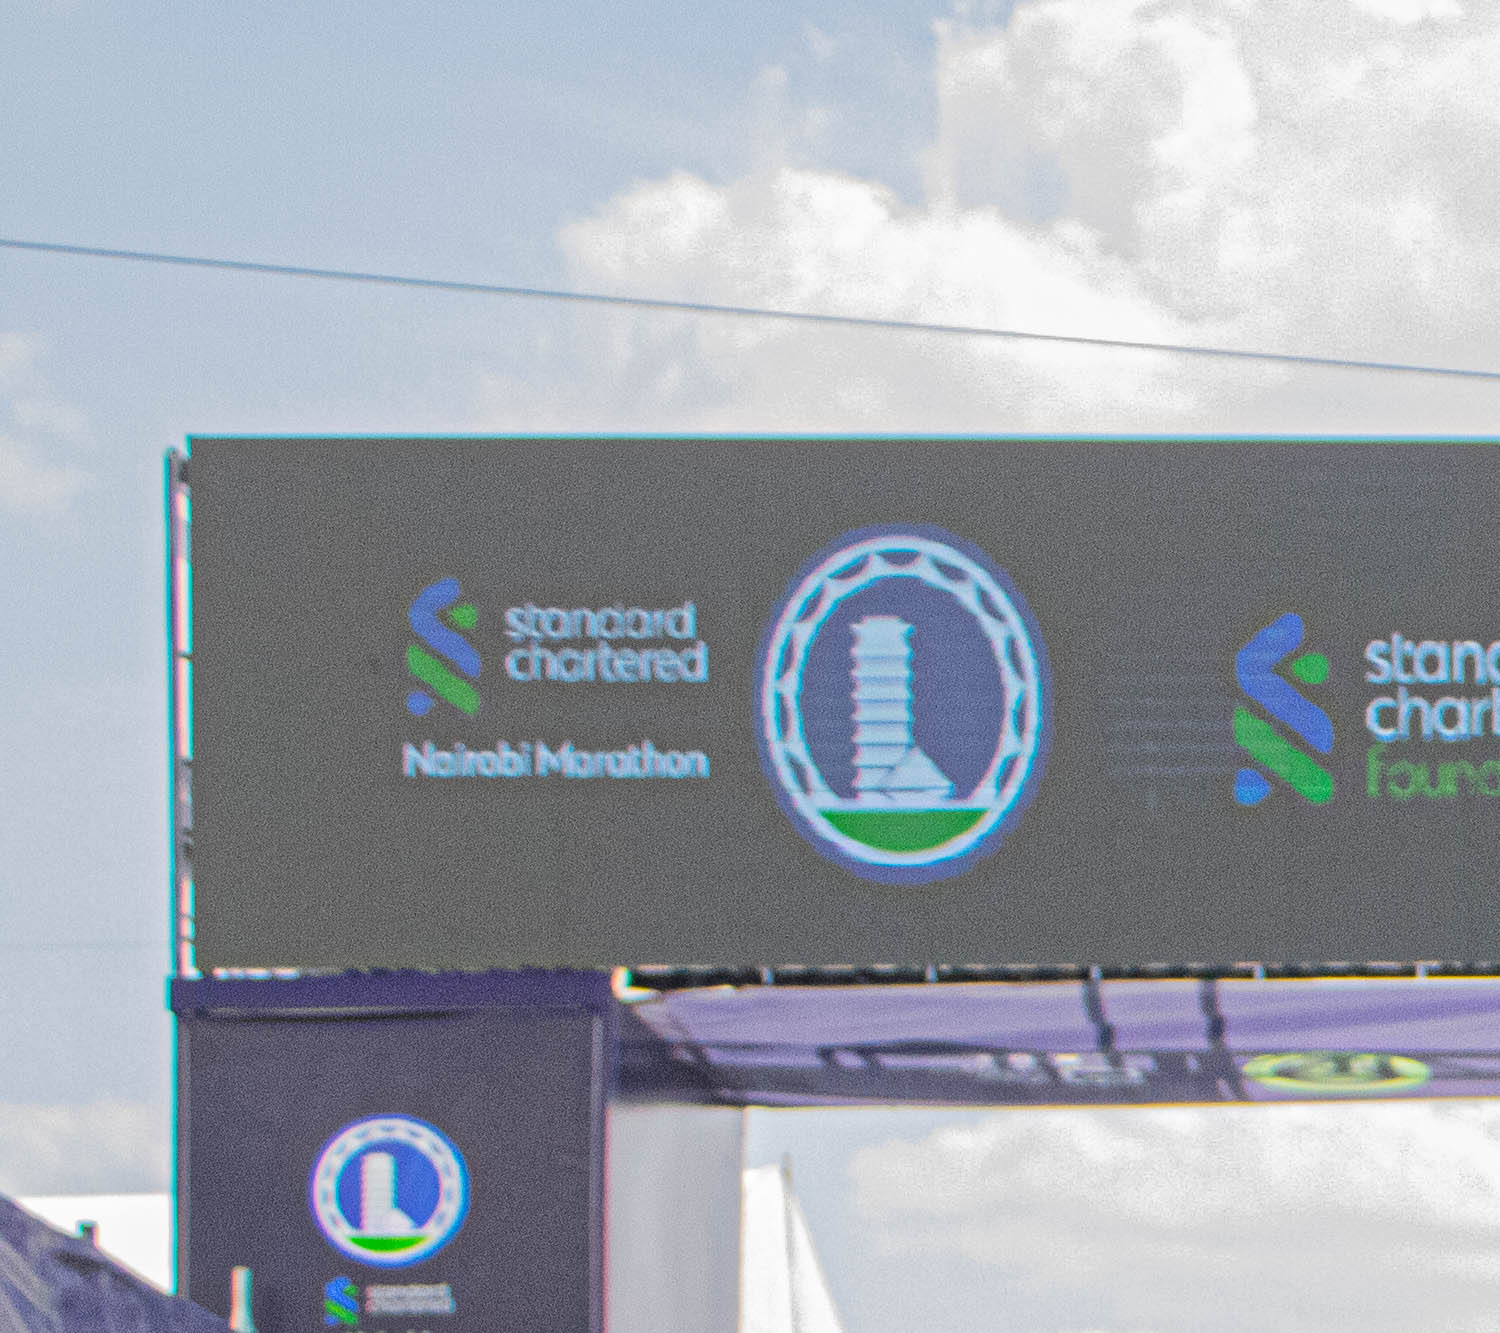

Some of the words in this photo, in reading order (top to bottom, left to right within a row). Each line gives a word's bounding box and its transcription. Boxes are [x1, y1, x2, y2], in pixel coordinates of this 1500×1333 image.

[504, 599, 698, 641] standard
[504, 640, 709, 684] chartered
[402, 739, 533, 779] Nairobi
[535, 739, 710, 779] Marathon
